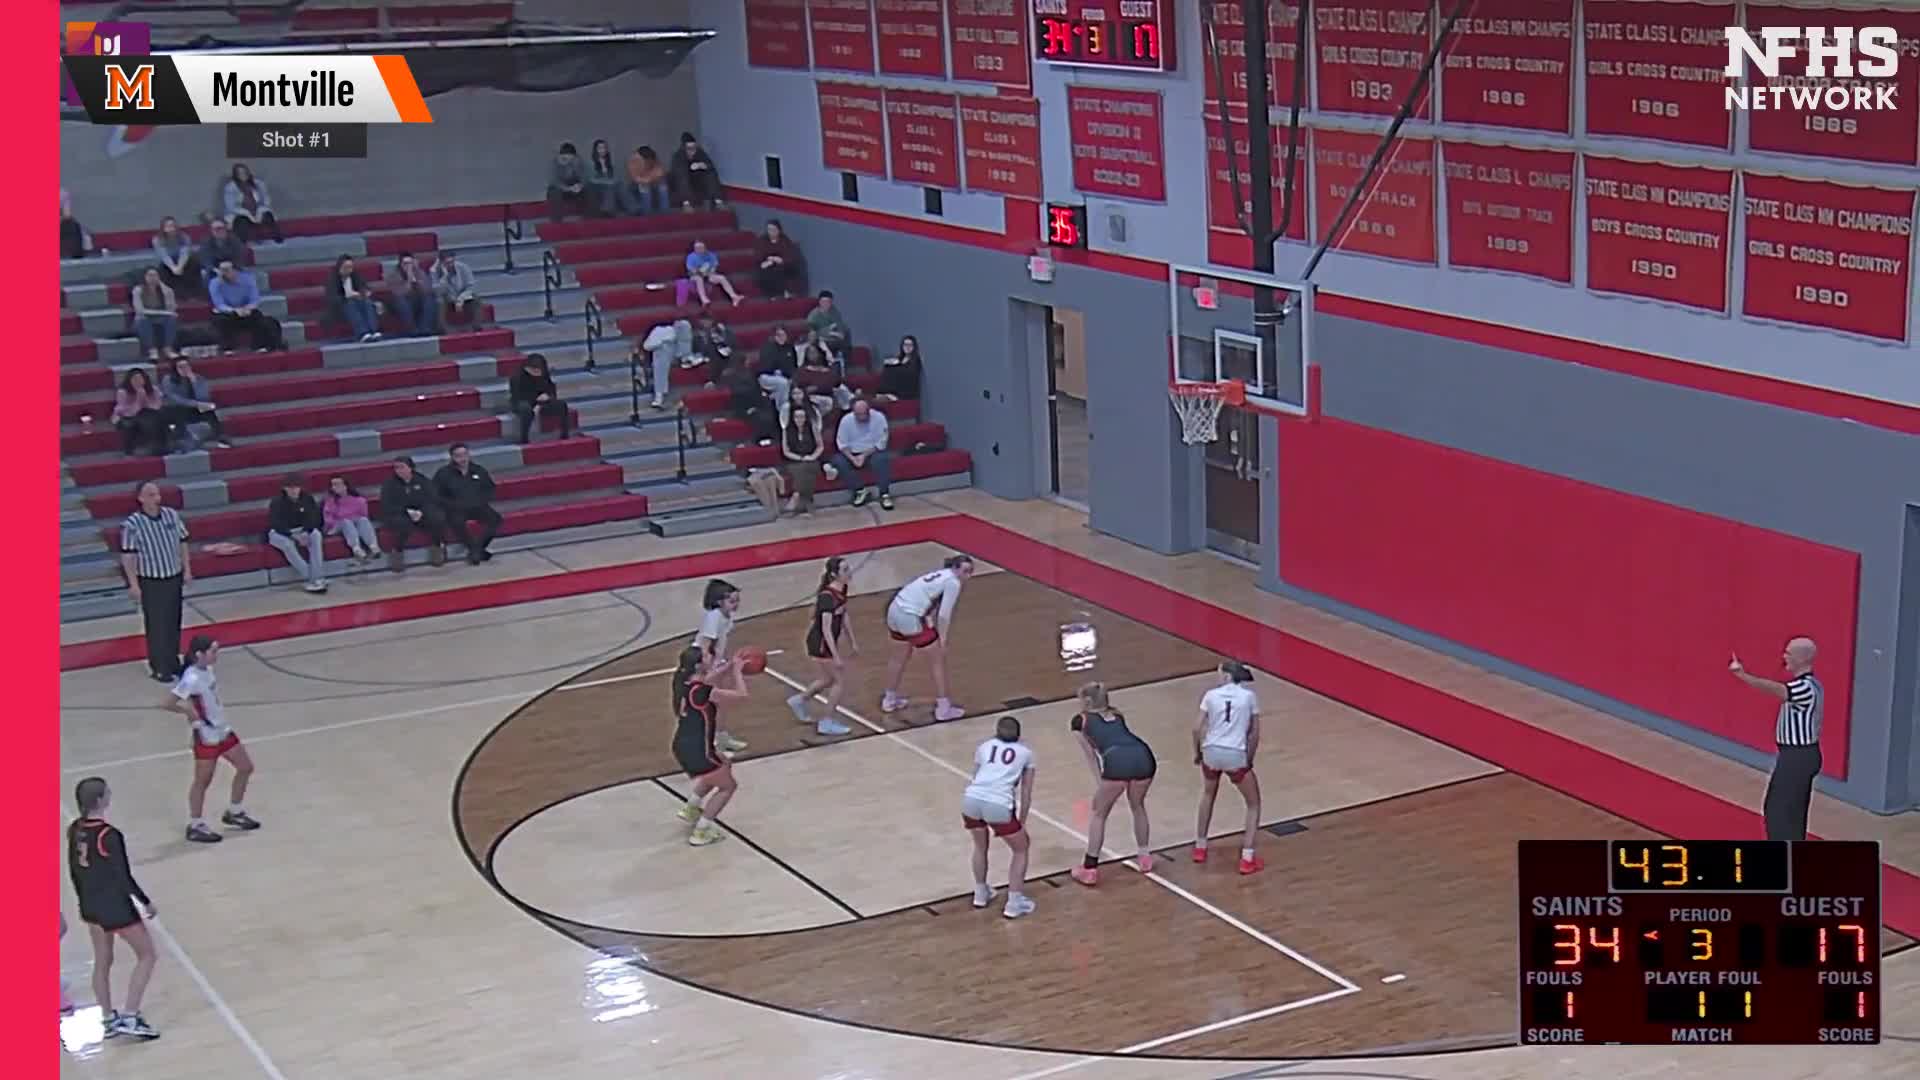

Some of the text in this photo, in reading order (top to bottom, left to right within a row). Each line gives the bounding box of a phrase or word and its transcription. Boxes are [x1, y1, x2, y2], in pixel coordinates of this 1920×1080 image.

[1120, 1, 1153, 17] GUEST
[1316, 8, 1346, 30] STATE
[1347, 9, 1377, 31] CLASS
[1089, 26, 1101, 53] 3
[1473, 19, 1509, 35] CLASS
[1527, 20, 1570, 38] CHAMPS
[1586, 22, 1622, 41] STATE
[1626, 24, 1667, 42] CLASS
[1669, 26, 1679, 43] L
[1349, 47, 1379, 66] CROSS
[1381, 48, 1423, 71] COUNTRY
[1446, 55, 1564, 74] BOYS CROSS COUNTRY
[1588, 60, 1623, 76] GIRLS
[1627, 62, 1667, 79] CROSS
[1350, 79, 1393, 101] 1983
[1631, 98, 1680, 118] 1986
[1446, 162, 1570, 192] STATE CLASS L CHAMPS
[1585, 178, 1619, 198] STATE
[1621, 183, 1649, 202] CLASS
[1668, 188, 1730, 212] CHAMPIONS
[1050, 207, 1077, 245] 35
[1746, 198, 1780, 219] STATE
[1784, 202, 1815, 224] CLASS
[1838, 209, 1911, 236] CHAMPIONS
[1592, 218, 1720, 249] BOYS CROSS COUNTRY
[1749, 240, 1901, 275] GIRLS CROSS COUNTRY
[1631, 259, 1677, 279] 1990
[1796, 285, 1848, 307] 1990
[1223, 700, 1233, 723] 1
[989, 745, 1016, 765] 10
